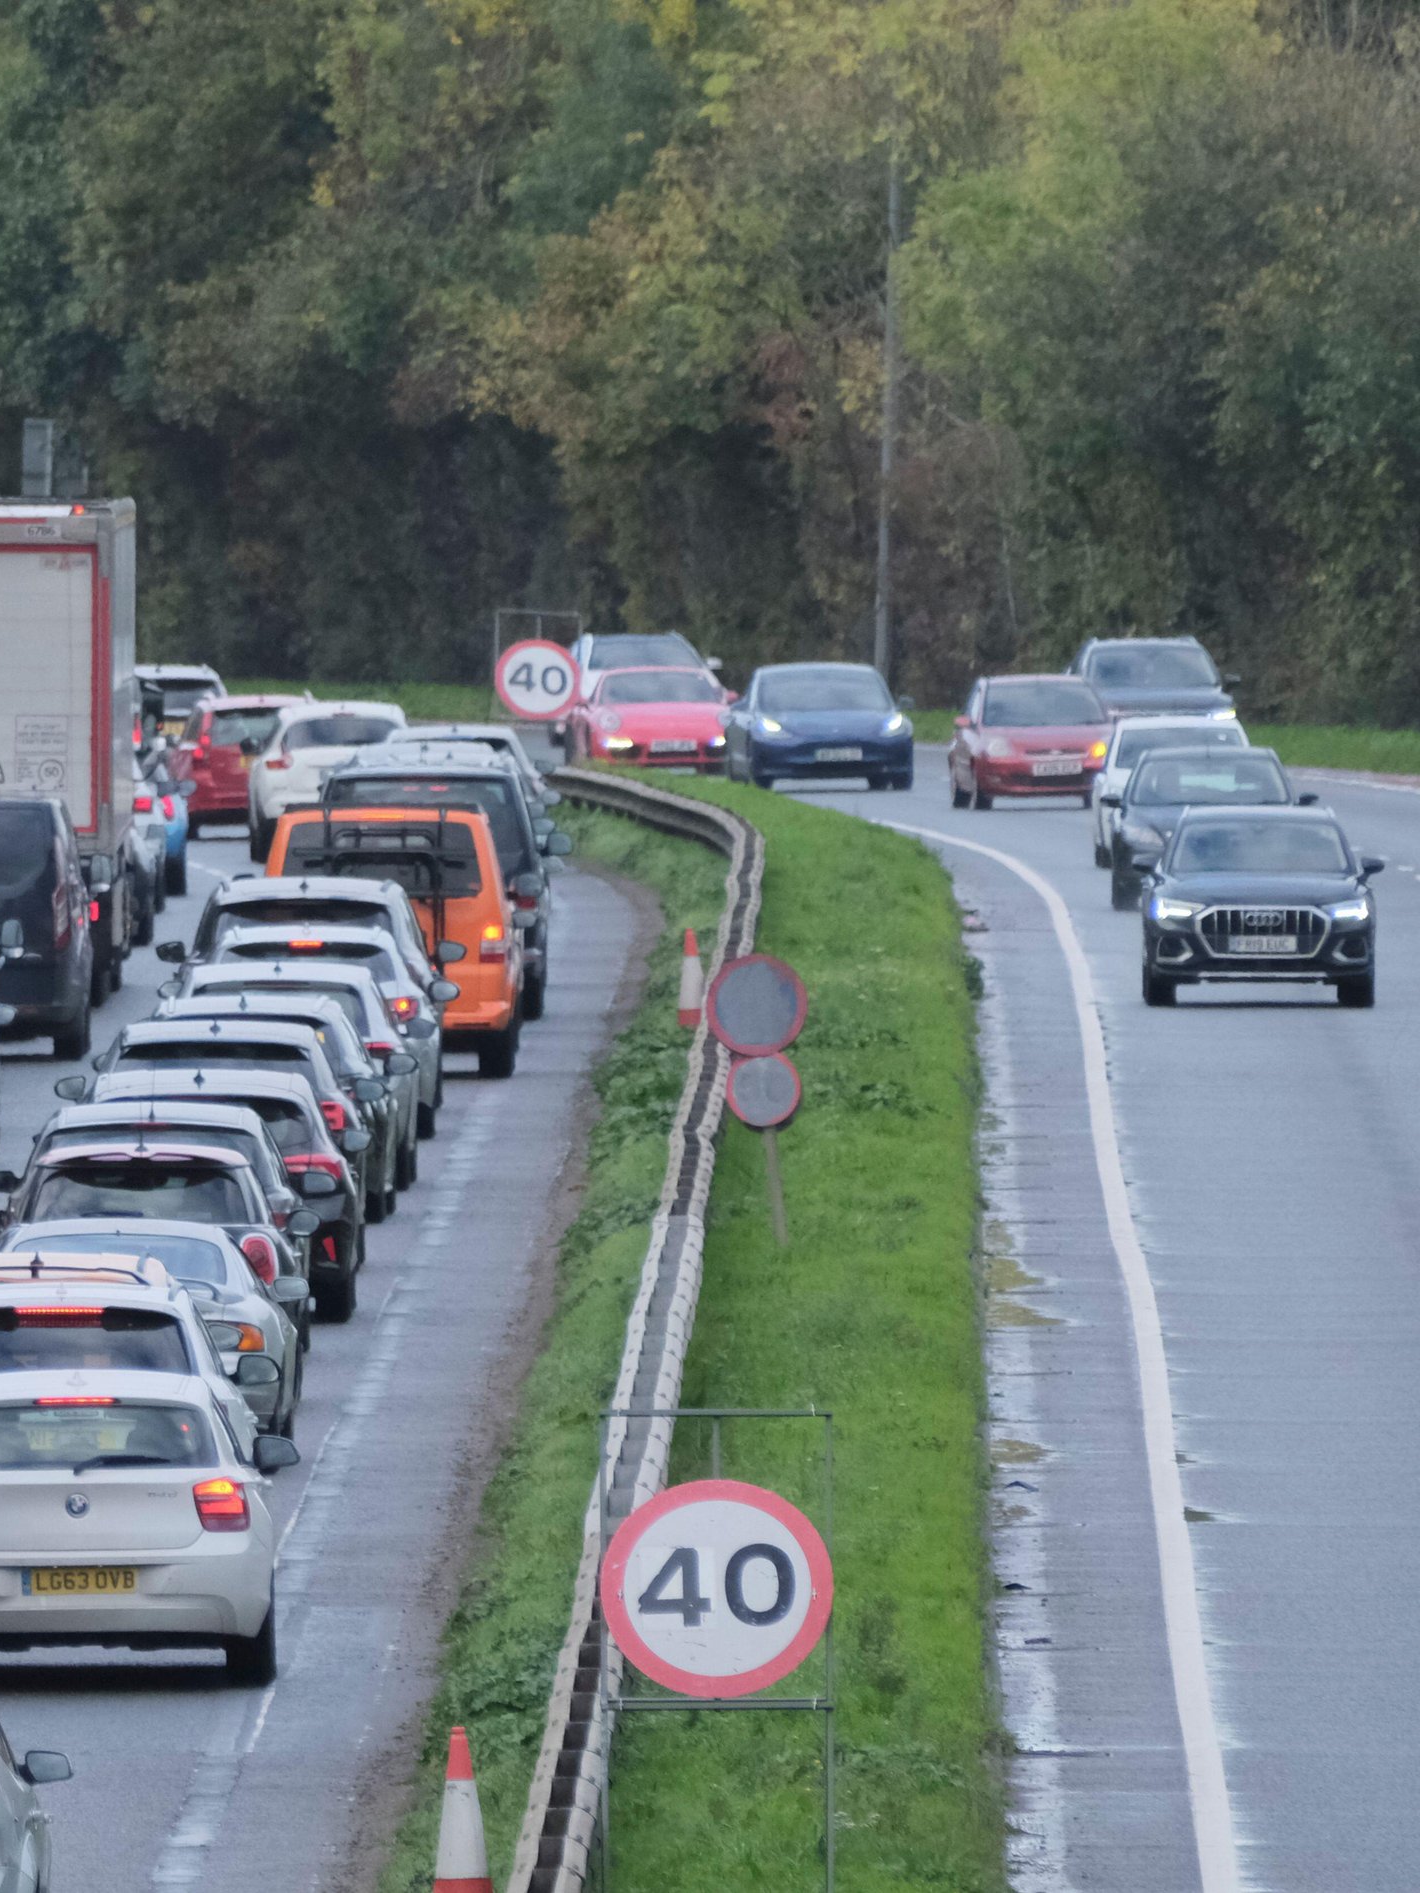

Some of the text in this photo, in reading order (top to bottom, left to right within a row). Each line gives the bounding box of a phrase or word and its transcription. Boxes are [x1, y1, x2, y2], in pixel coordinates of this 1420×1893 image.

[508, 662, 568, 696] 40
[35, 1570, 135, 1591] LG63 OVB
[638, 1542, 796, 1628] 40
